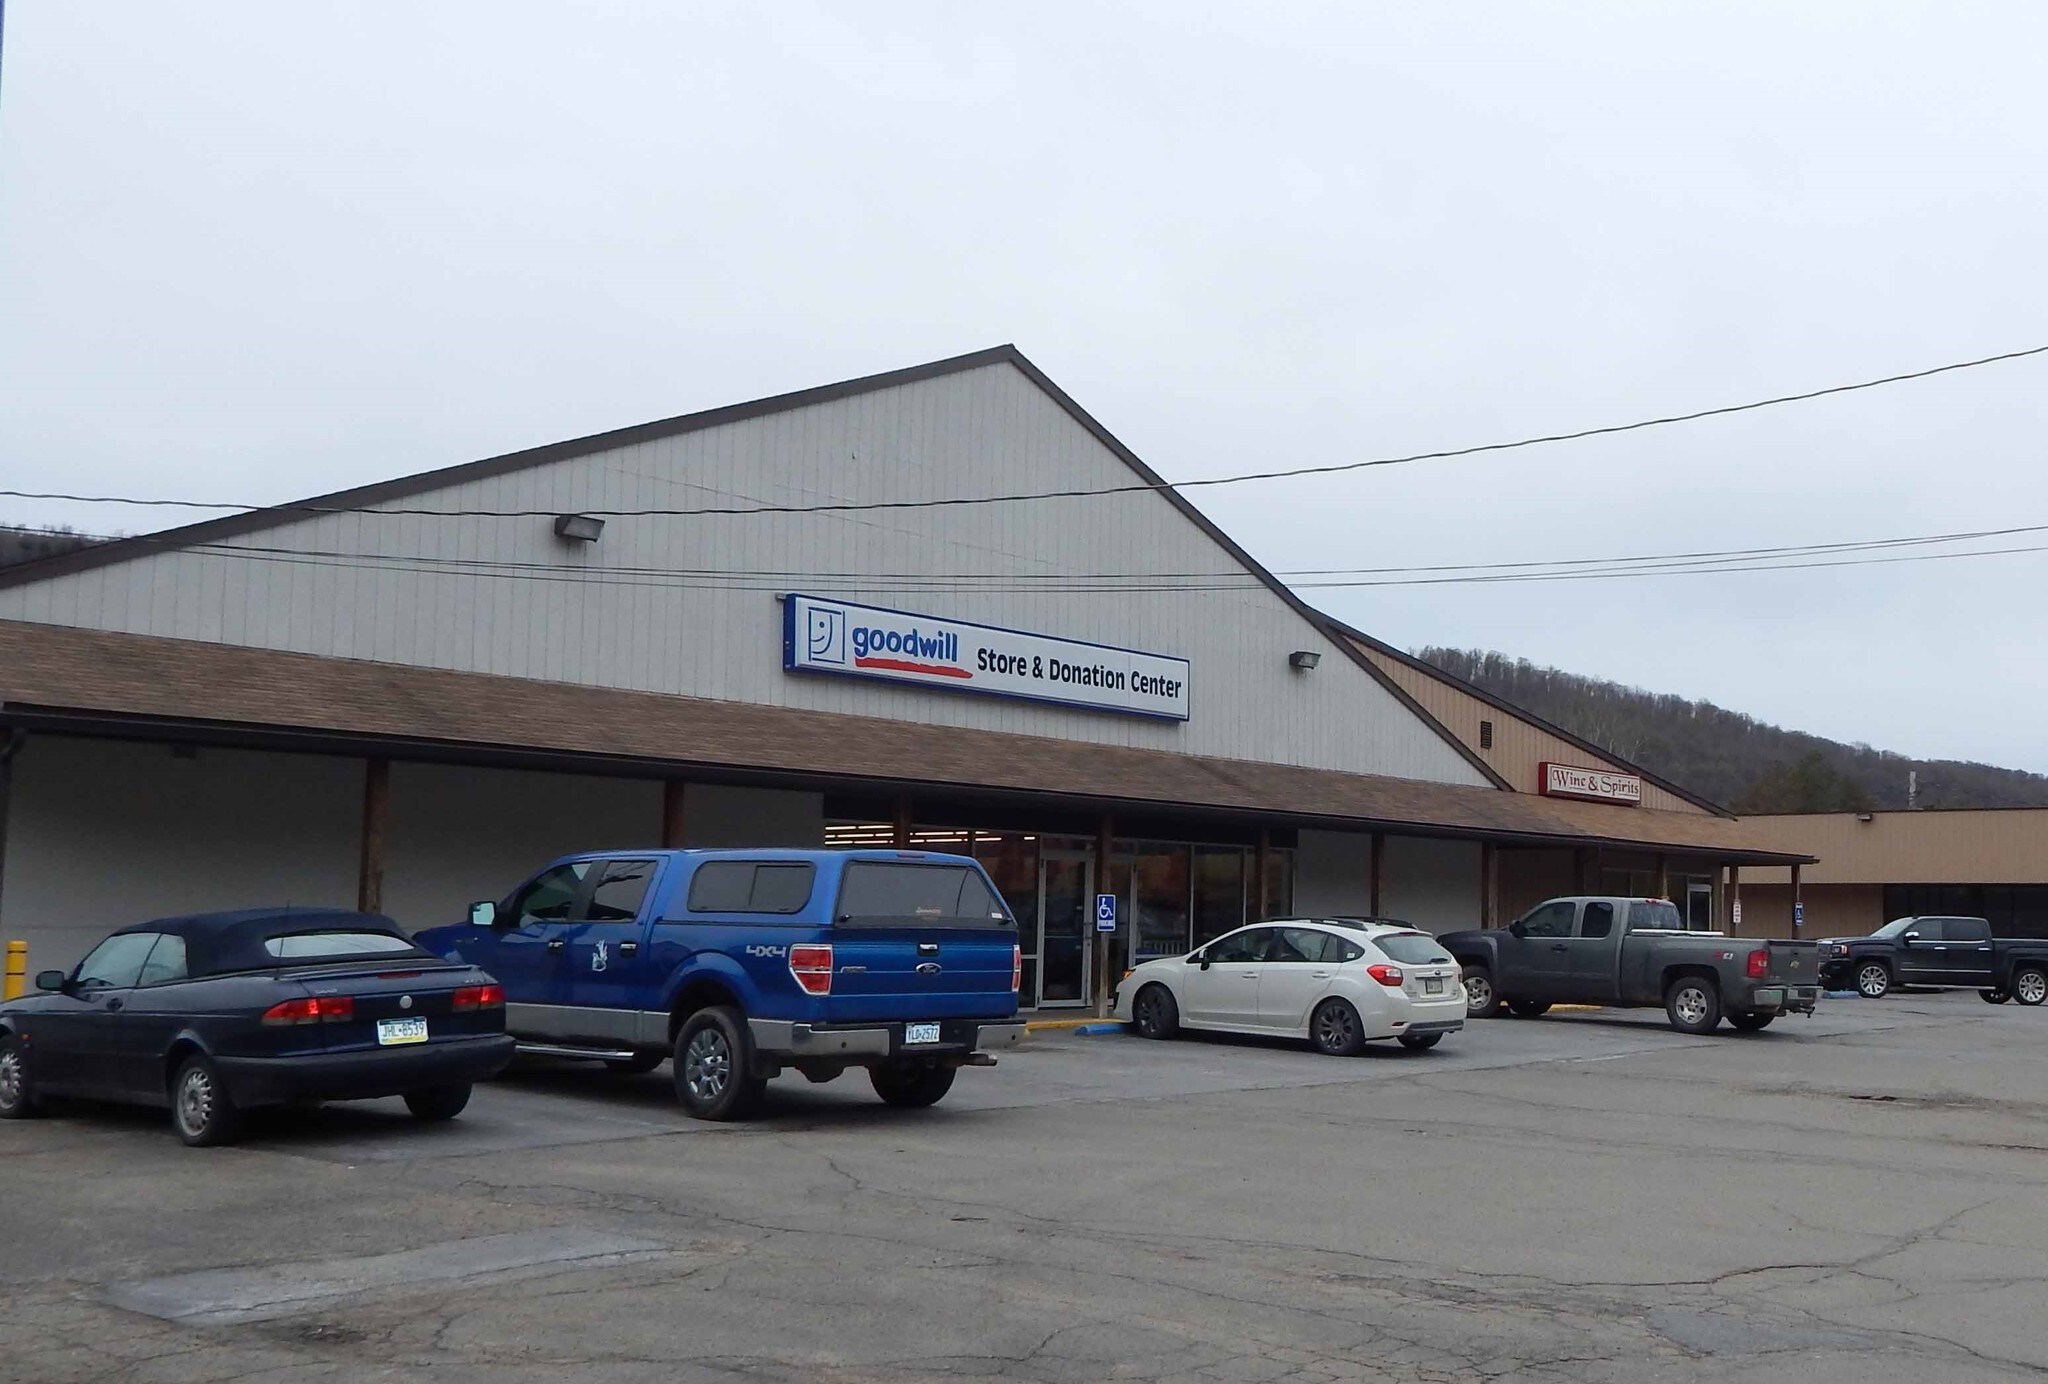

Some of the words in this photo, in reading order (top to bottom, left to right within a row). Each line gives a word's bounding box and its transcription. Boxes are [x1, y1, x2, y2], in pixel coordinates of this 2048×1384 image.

[853, 626, 958, 662] goodwill
[977, 648, 1027, 677] Store
[1032, 656, 1044, 680] &
[1049, 659, 1125, 691] Donation
[1131, 671, 1182, 699] Center
[1552, 769, 1587, 788] Wine
[1588, 776, 1598, 791] &
[1600, 776, 1639, 796] Spirits
